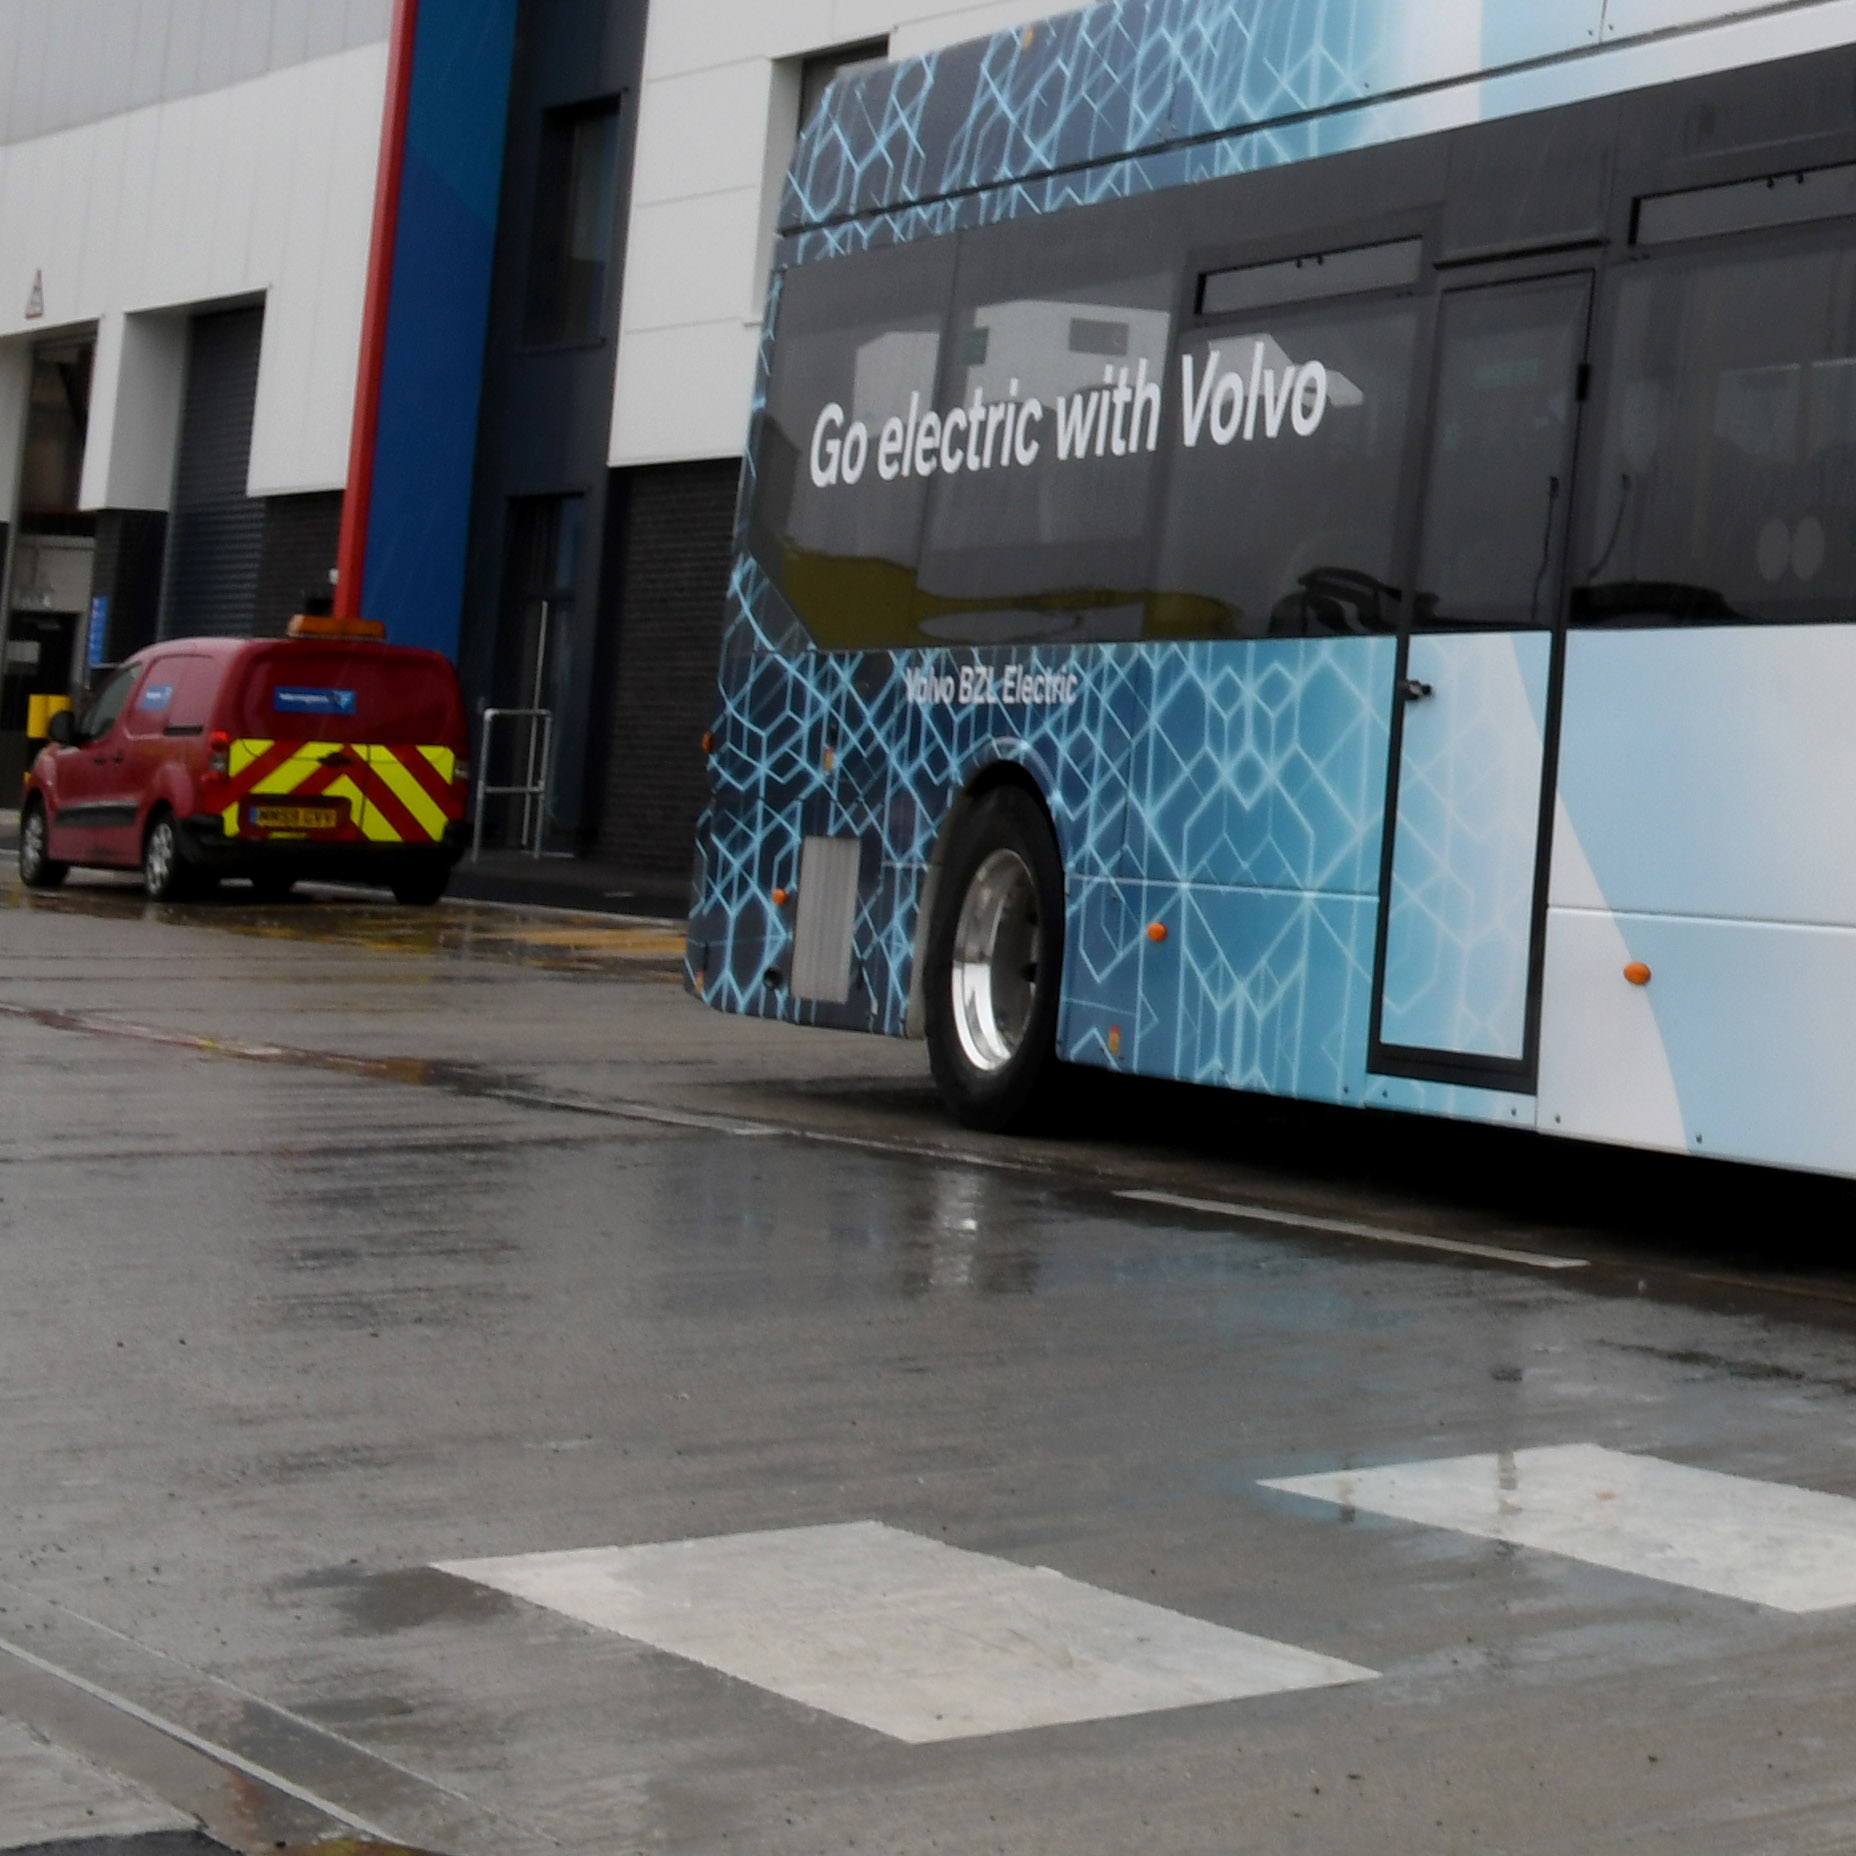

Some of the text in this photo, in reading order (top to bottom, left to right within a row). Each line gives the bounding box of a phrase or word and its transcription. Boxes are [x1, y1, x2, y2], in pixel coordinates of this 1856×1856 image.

[810, 342, 1327, 488] Go electric with Volvo
[906, 663, 1077, 705] Volvo BZL Electric
